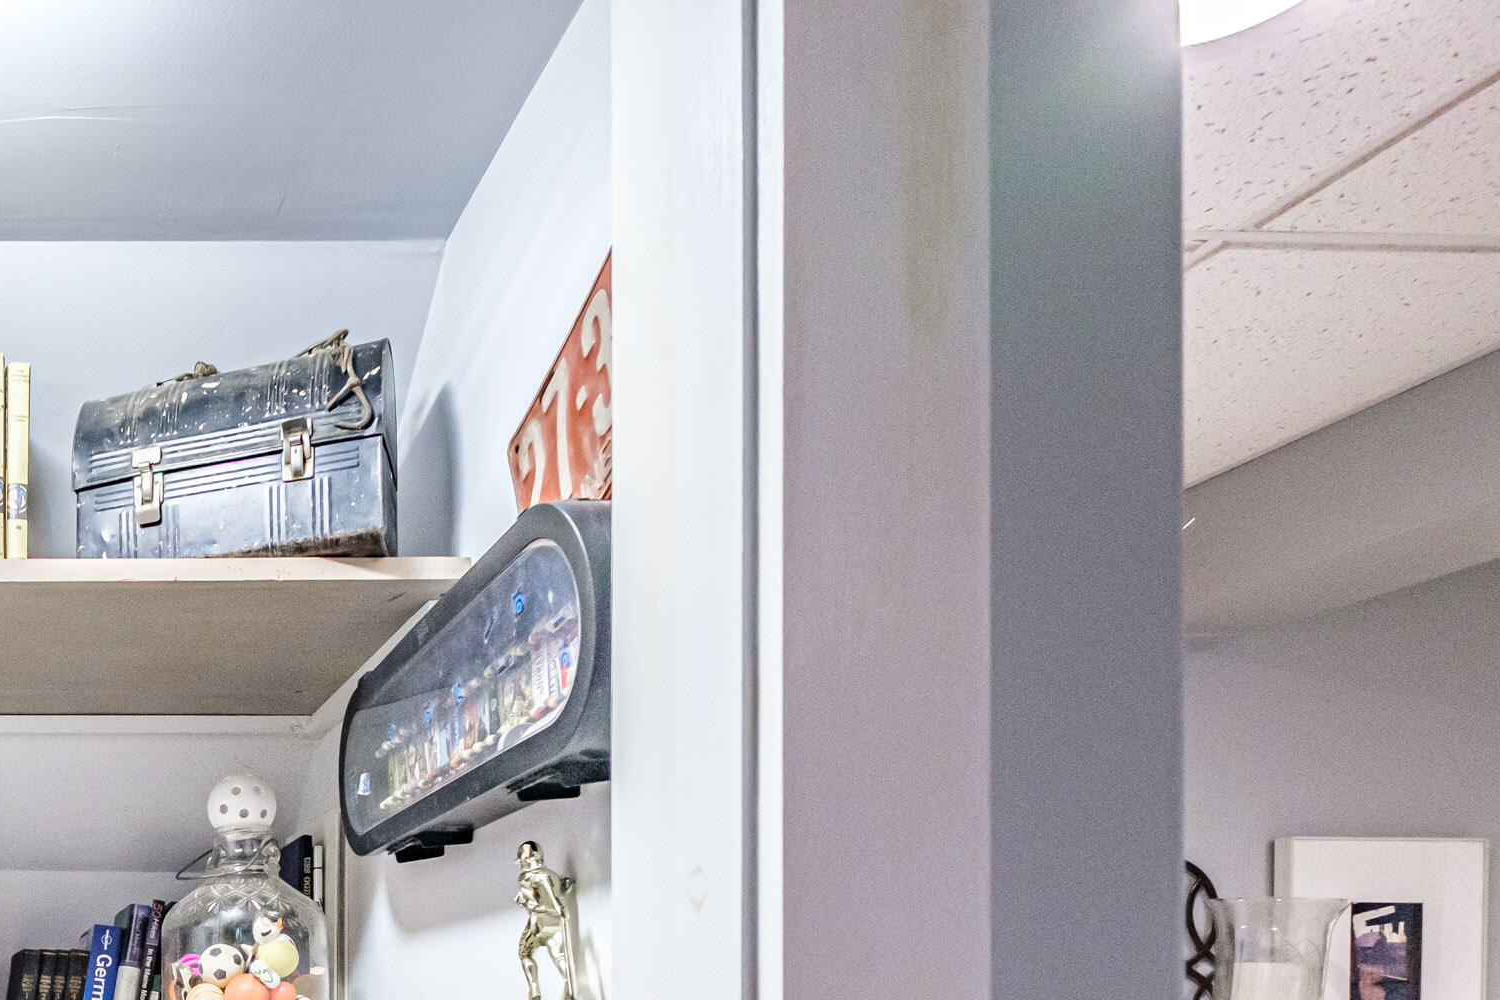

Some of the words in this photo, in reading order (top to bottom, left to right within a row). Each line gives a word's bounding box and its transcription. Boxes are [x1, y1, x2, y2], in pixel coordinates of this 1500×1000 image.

[303, 856, 311, 873] USS
[303, 875, 311, 897] OGD
[149, 917, 159, 939] Hikes
[145, 956, 153, 967] the
[141, 968, 152, 989] Maine
